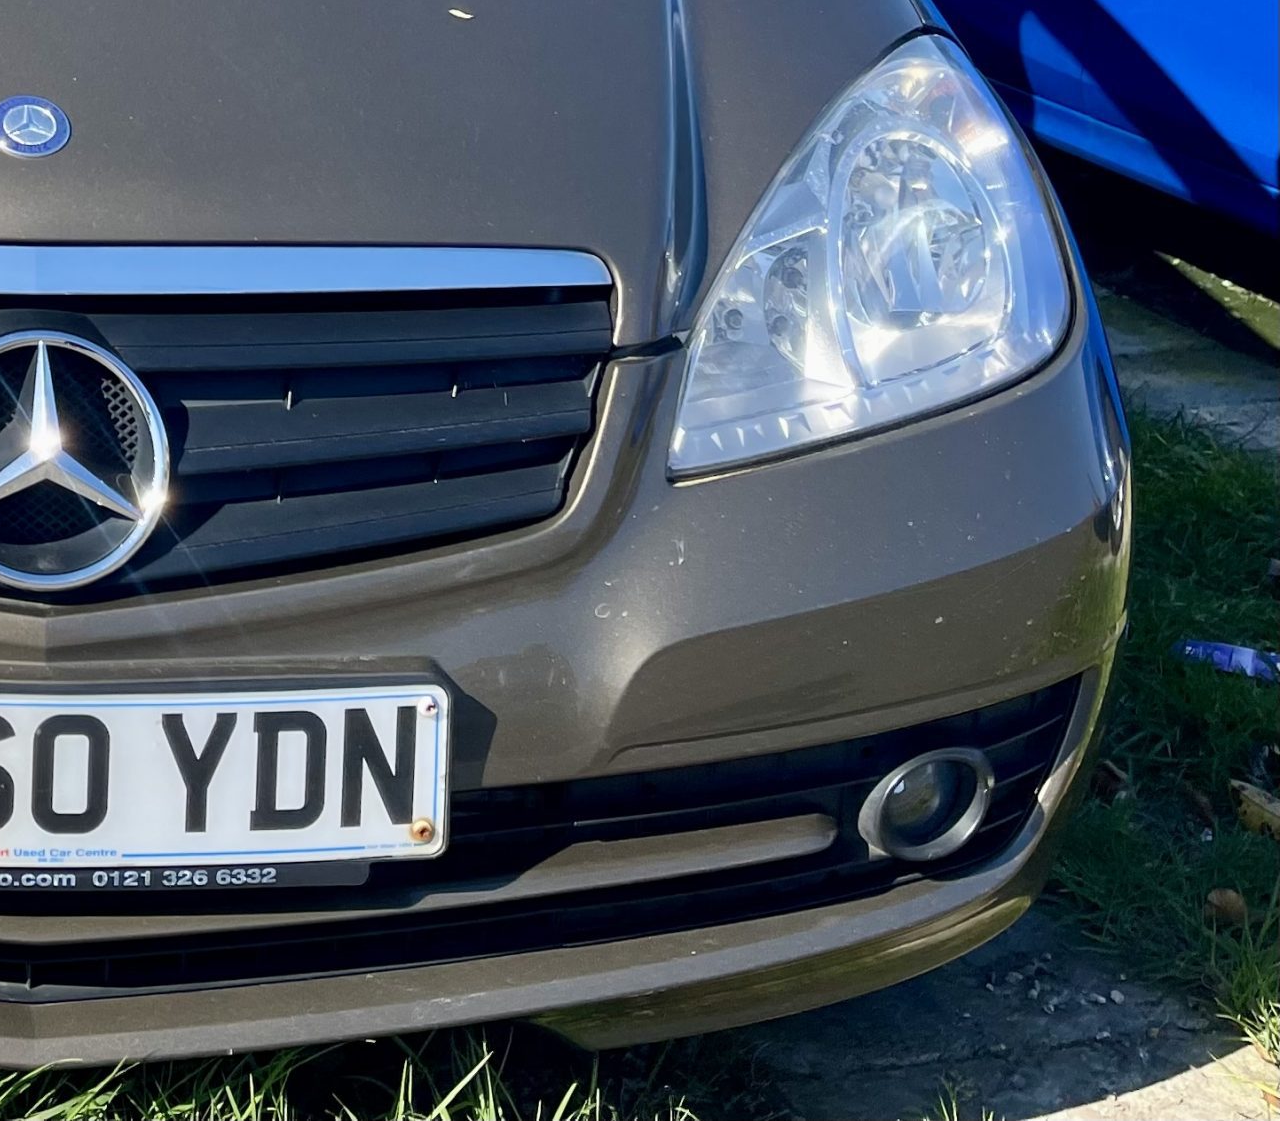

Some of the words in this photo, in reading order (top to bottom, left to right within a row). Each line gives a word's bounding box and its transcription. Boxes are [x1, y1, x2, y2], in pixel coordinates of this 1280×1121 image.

[161, 705, 419, 833] YDN
[13, 847, 46, 858] Used
[49, 847, 72, 858] Car
[75, 847, 118, 858] Centre
[91, 869, 152, 888] 0121
[162, 868, 209, 887] 326
[215, 867, 278, 886] 6332
